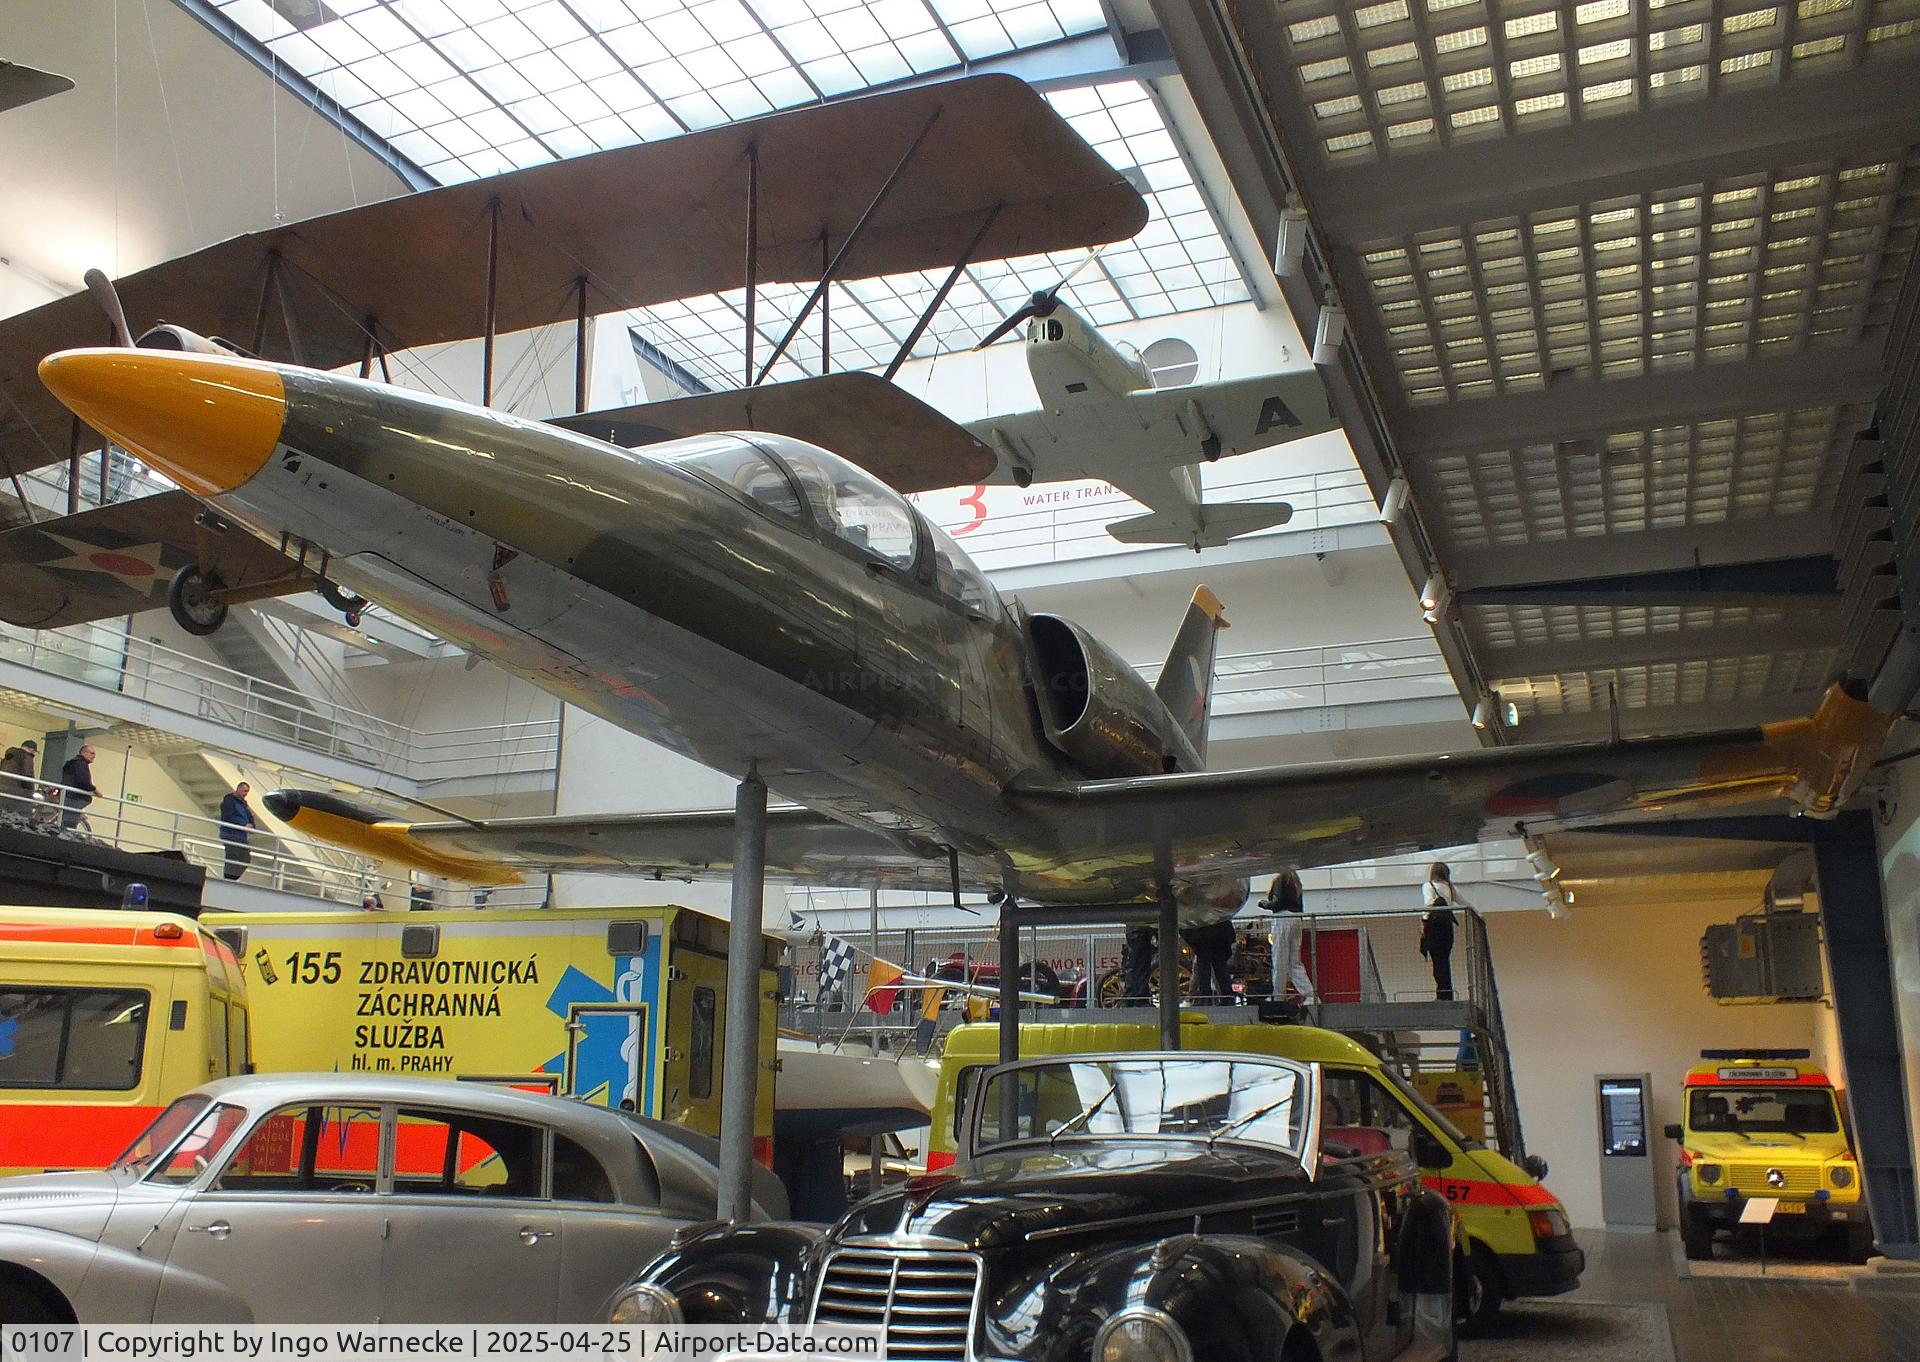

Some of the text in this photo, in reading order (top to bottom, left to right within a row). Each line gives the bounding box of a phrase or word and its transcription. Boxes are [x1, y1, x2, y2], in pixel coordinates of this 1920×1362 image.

[1254, 396, 1303, 435] A
[1023, 490, 1070, 506] WATER
[286, 951, 342, 985] 155
[359, 953, 539, 985] ZDRAVOTNICKÁ
[357, 986, 501, 1017] ZÁCHRANNÁ
[355, 1018, 445, 1049] SLUŽBA
[351, 1054, 454, 1072] hl. m. PRAHY
[1446, 1185, 1471, 1200] 57
